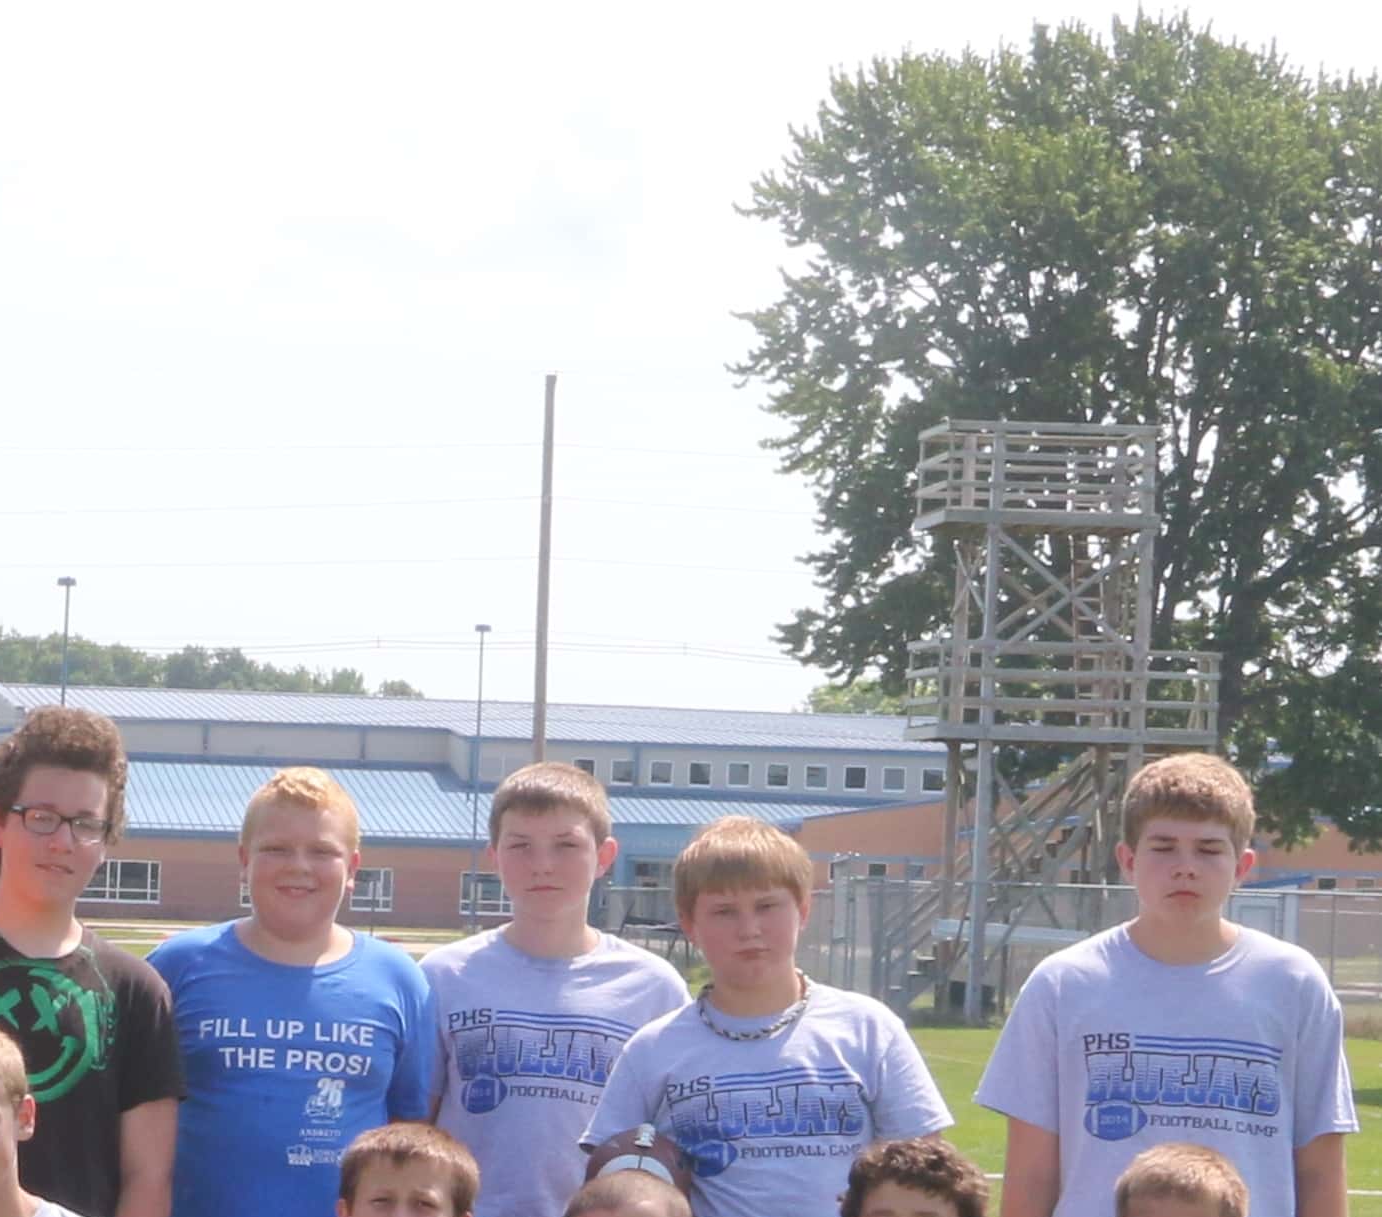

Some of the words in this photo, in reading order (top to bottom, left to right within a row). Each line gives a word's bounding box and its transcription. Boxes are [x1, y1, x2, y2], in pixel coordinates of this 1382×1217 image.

[448, 1008, 492, 1030] PHS
[199, 1017, 257, 1040] FILL
[266, 1019, 305, 1041] UP
[314, 1022, 375, 1047] LIKE
[1083, 1033, 1131, 1052] PHS
[218, 1046, 276, 1070] THE
[285, 1048, 373, 1077] PROS!
[316, 1077, 347, 1108] 26
[509, 1085, 586, 1105] FOOTBALL
[1149, 1114, 1233, 1132] FOOTBALL
[1235, 1120, 1279, 1138] CAMP
[739, 1144, 826, 1160] FOOTBALL
